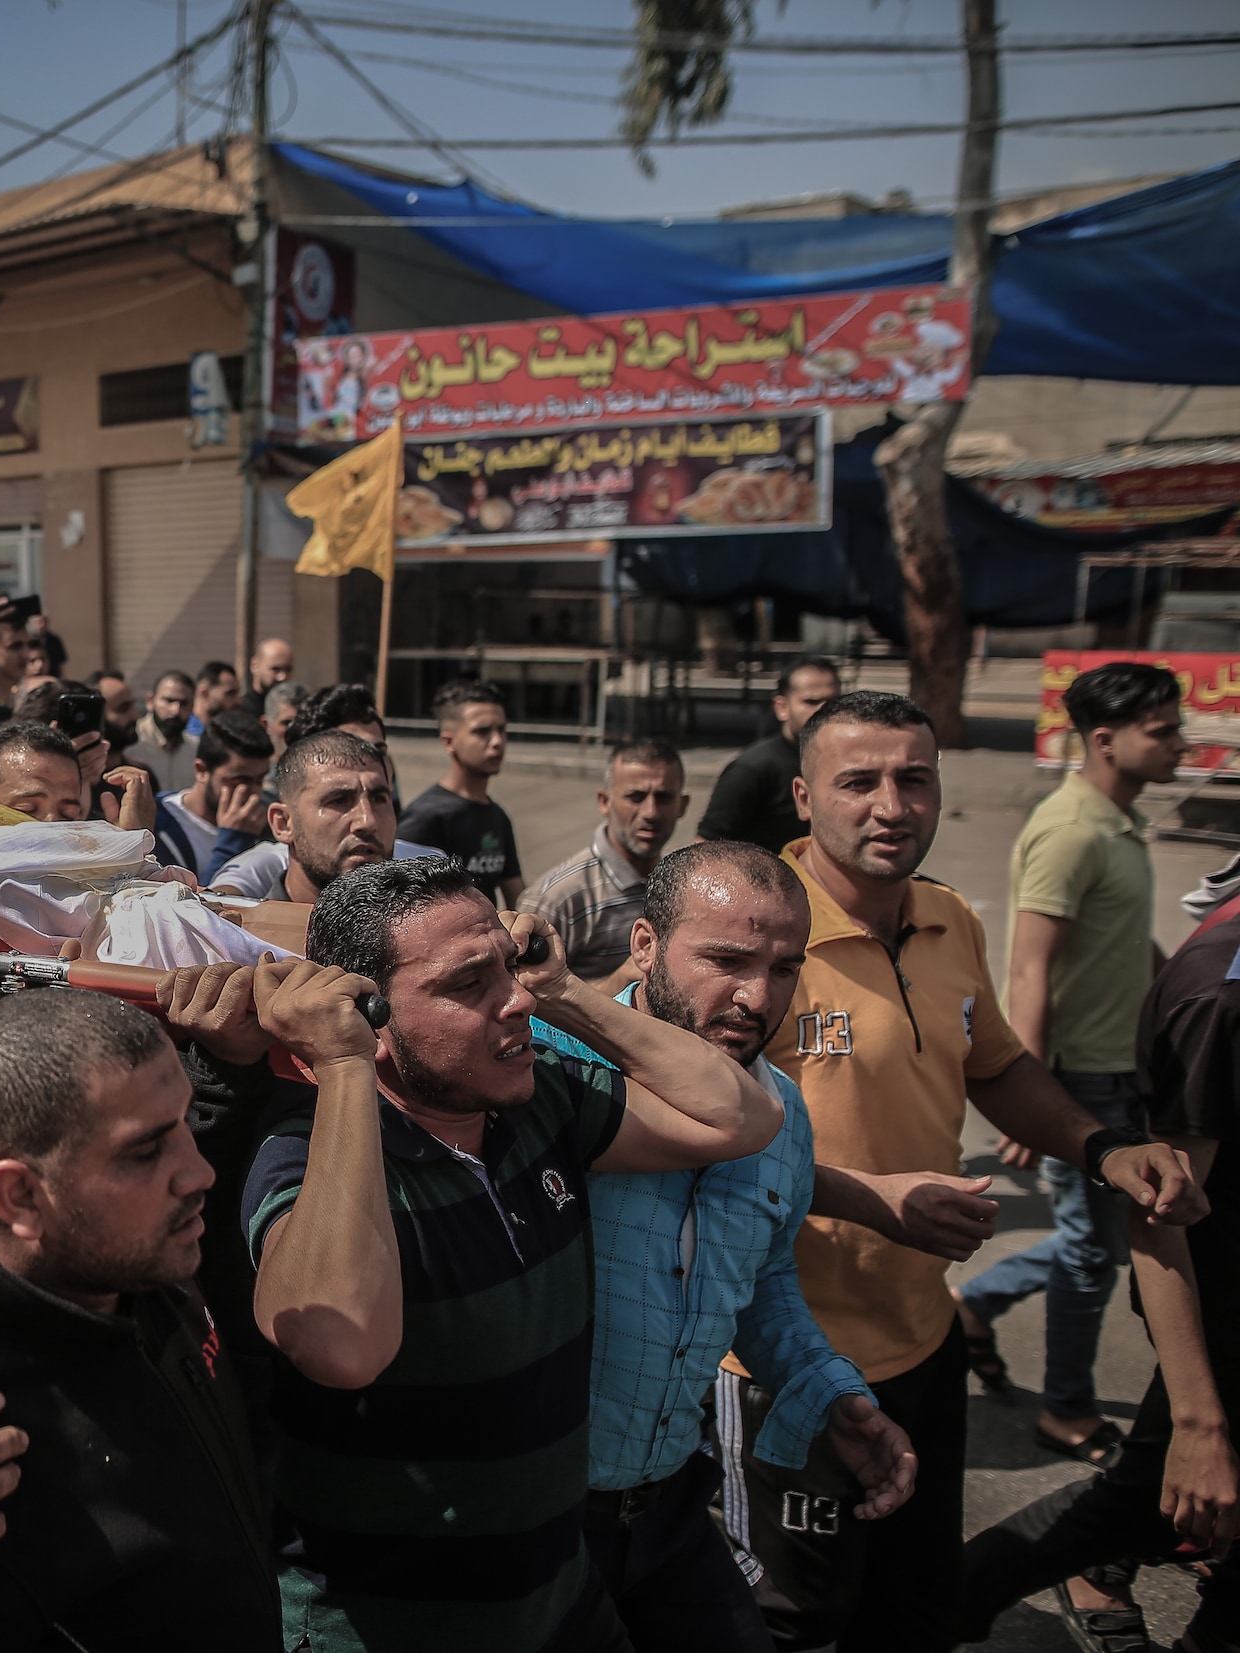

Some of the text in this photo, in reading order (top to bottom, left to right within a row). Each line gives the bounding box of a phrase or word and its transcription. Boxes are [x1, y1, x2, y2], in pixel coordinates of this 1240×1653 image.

[398, 306, 807, 401] استراحة بيت حانون
[572, 428, 635, 472] زمان
[686, 417, 782, 465] قطايف
[798, 1010, 853, 1055] 03
[782, 1490, 840, 1535] 03
